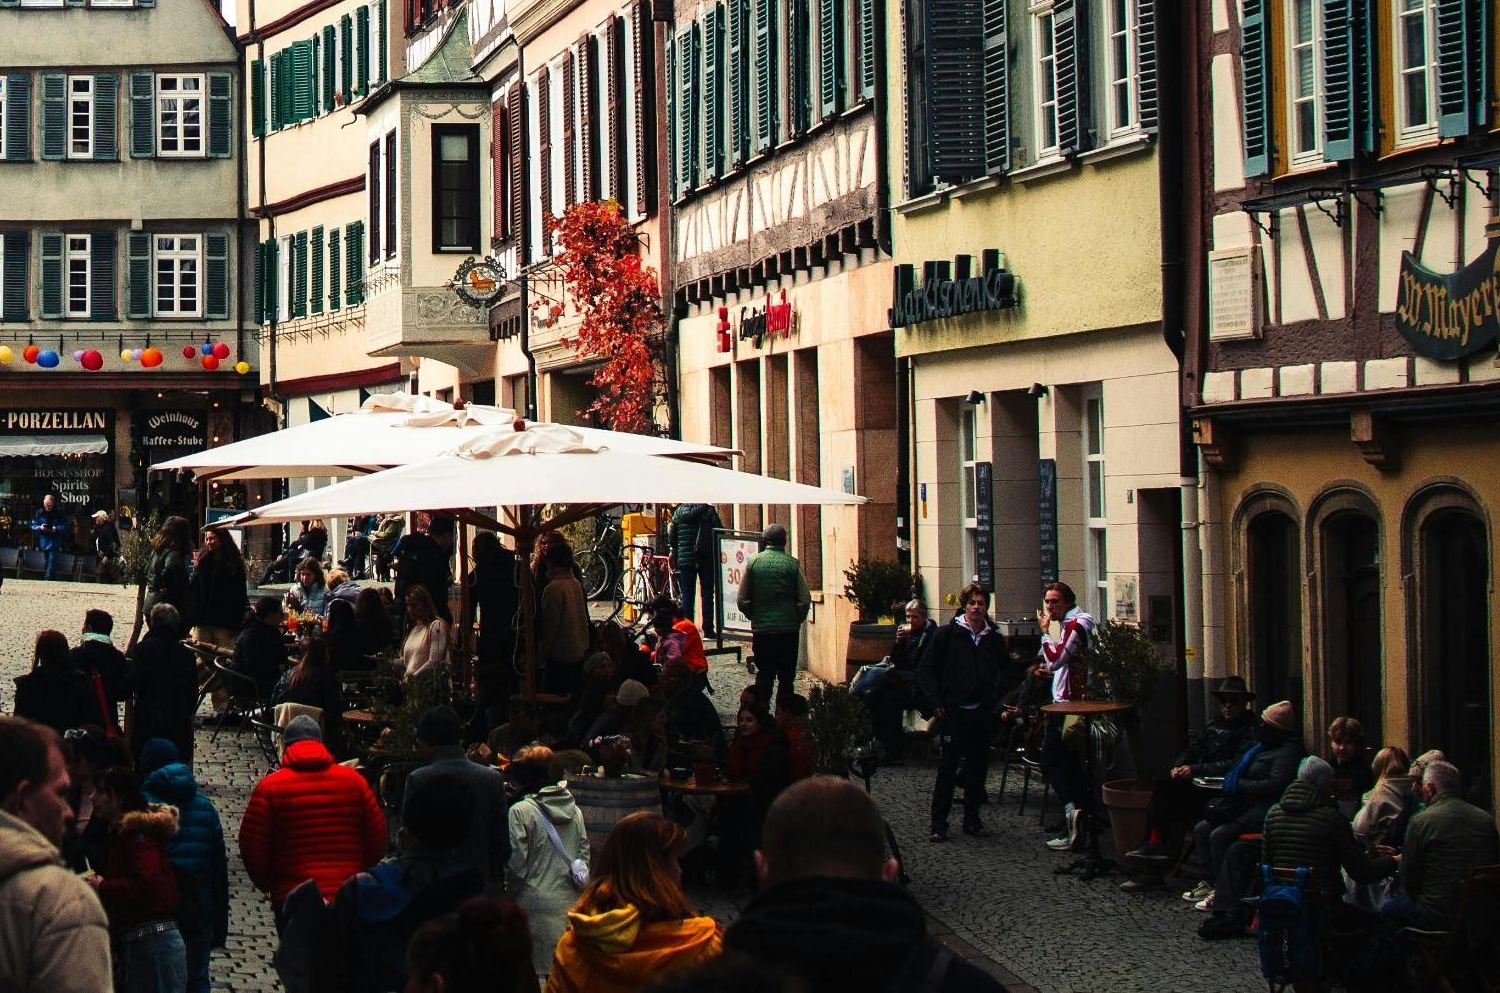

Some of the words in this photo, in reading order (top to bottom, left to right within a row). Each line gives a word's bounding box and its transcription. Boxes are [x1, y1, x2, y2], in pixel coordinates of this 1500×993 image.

[1422, 277, 1494, 346] Mayer
[148, 410, 200, 429] Weinhaus
[142, 435, 204, 446] Kaffee-Stube
[51, 479, 90, 493] Spirits
[60, 491, 91, 506] Shop
